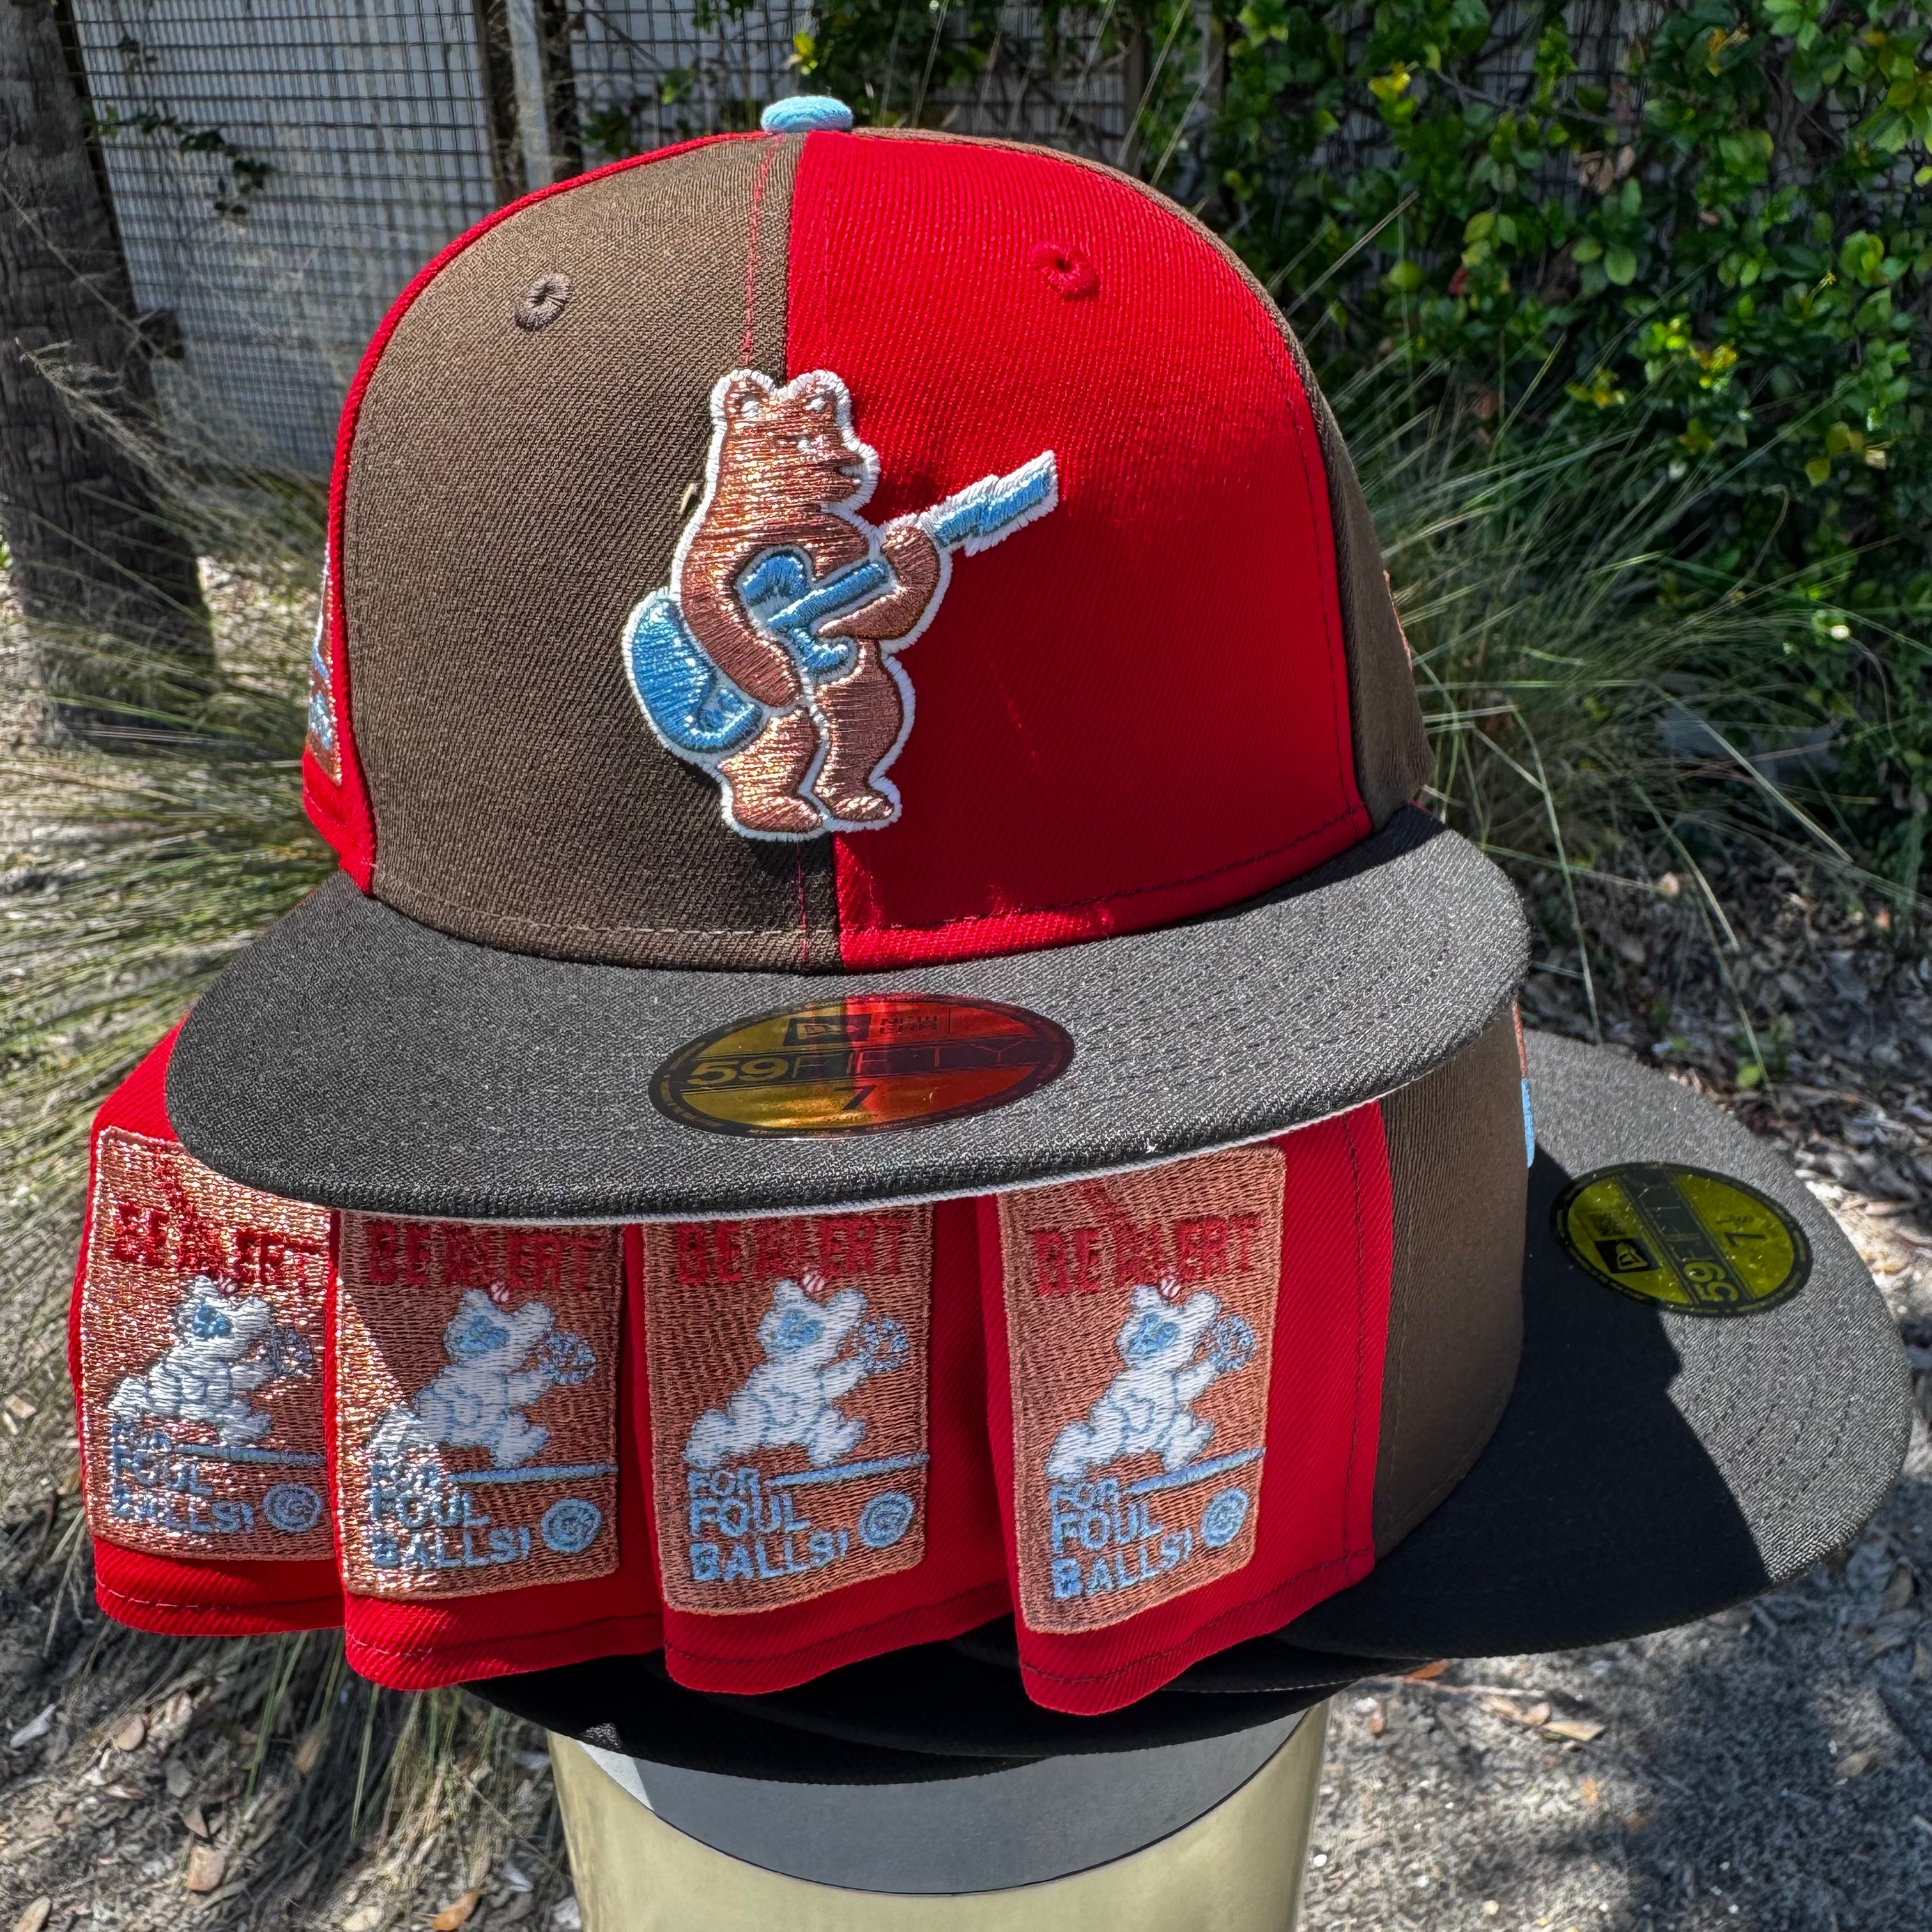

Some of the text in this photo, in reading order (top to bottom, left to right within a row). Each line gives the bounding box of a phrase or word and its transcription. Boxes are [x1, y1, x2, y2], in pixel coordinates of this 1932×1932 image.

[687, 1467, 760, 1498] FOR
[1050, 1478, 1121, 1513] FOR
[689, 1491, 811, 1538] FOUL
[1051, 1501, 1165, 1554] FOUL
